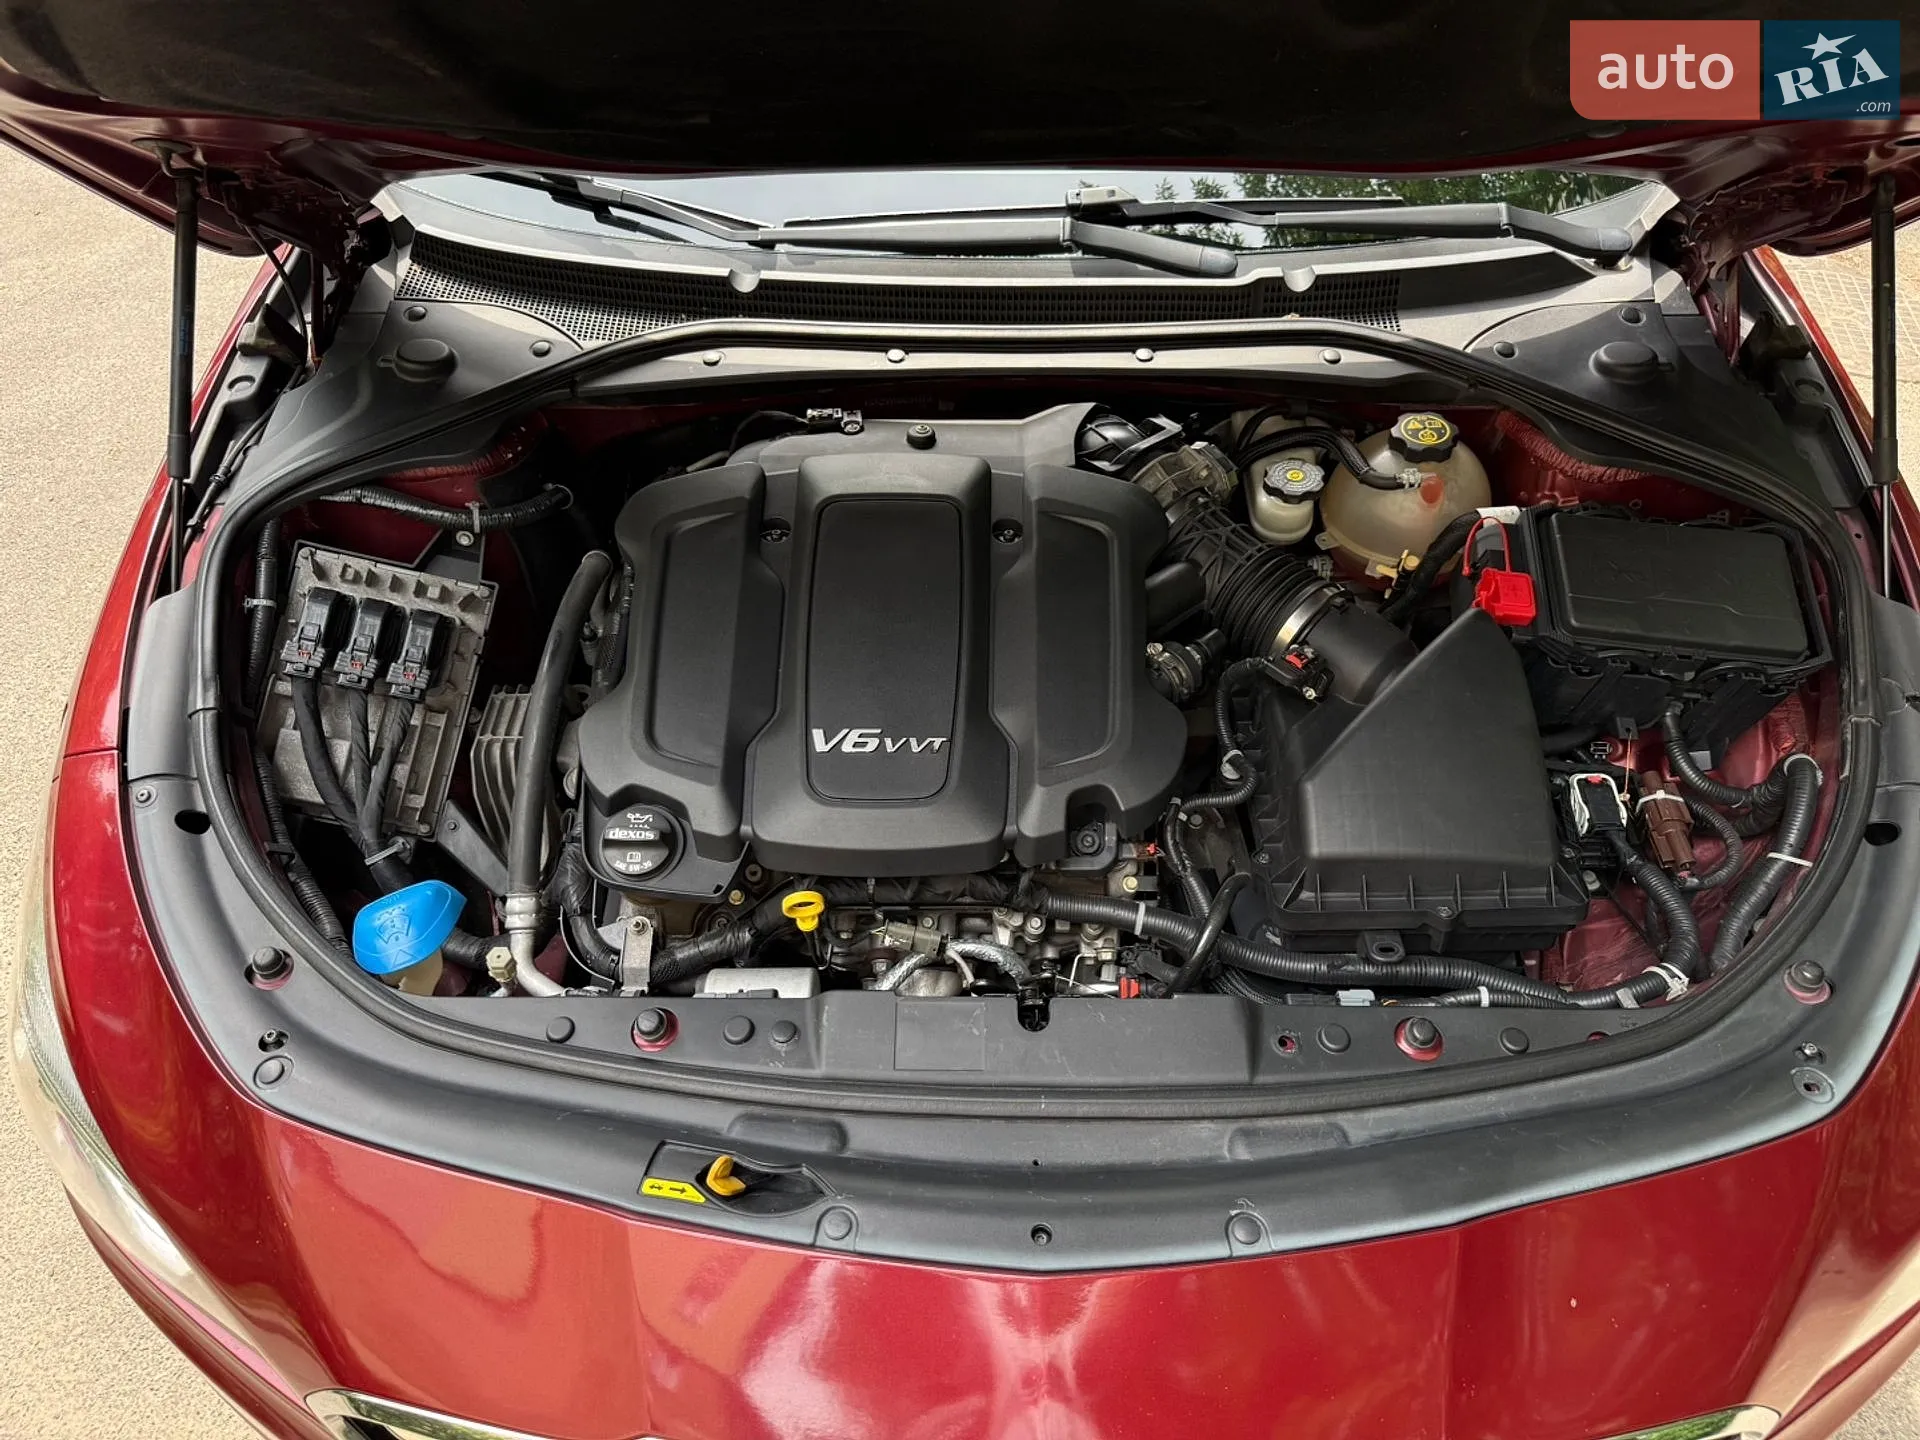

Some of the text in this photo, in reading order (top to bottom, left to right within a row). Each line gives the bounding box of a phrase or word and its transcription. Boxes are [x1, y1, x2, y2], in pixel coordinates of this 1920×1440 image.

[812, 728, 948, 753] V6 VVT
[608, 827, 655, 840] dexos
